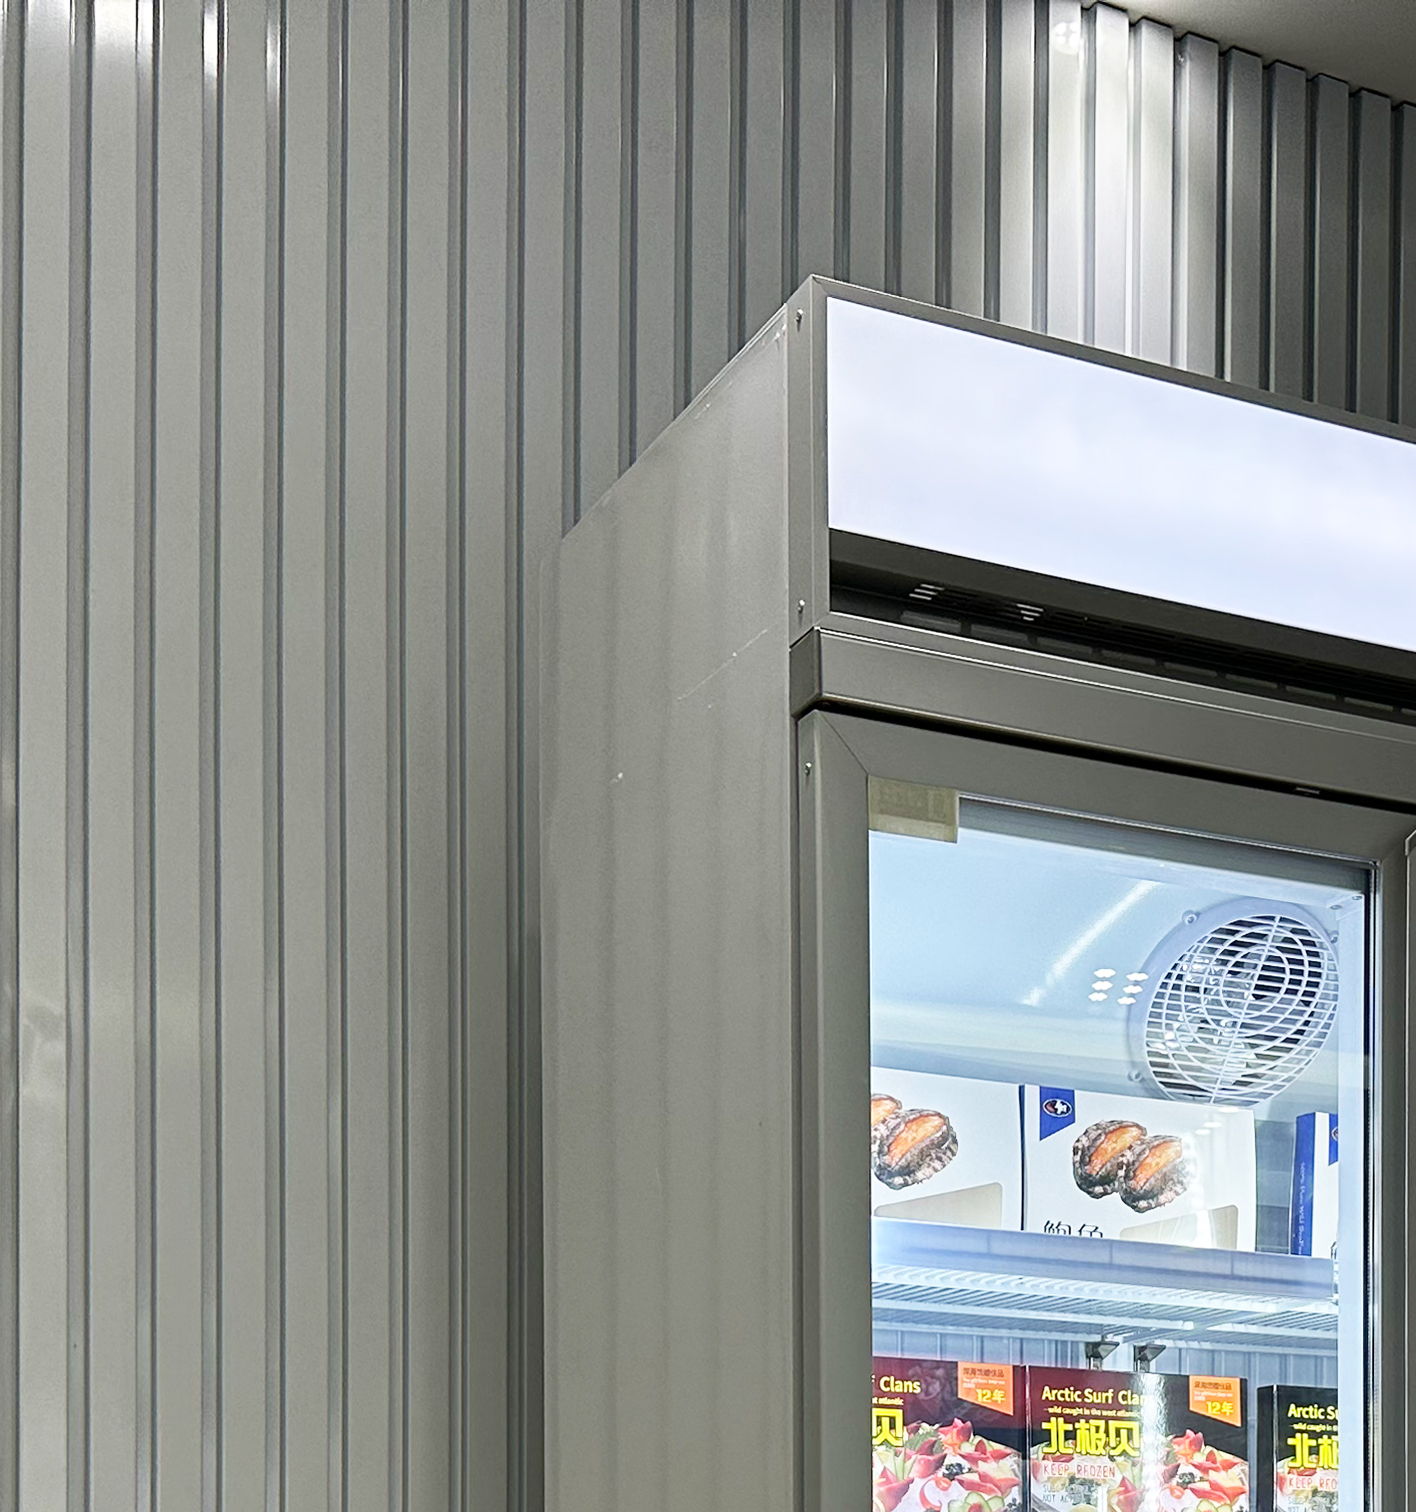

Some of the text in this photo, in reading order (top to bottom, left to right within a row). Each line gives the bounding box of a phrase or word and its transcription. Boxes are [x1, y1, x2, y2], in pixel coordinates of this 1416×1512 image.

[880, 1376, 921, 1394] Clans
[976, 1389, 1006, 1404] 12年
[1042, 1386, 1154, 1405] Arctic Surf Cla
[1206, 1402, 1234, 1416] 12年
[1288, 1403, 1325, 1419] Arctic
[1041, 1417, 1140, 1457] 北极贝
